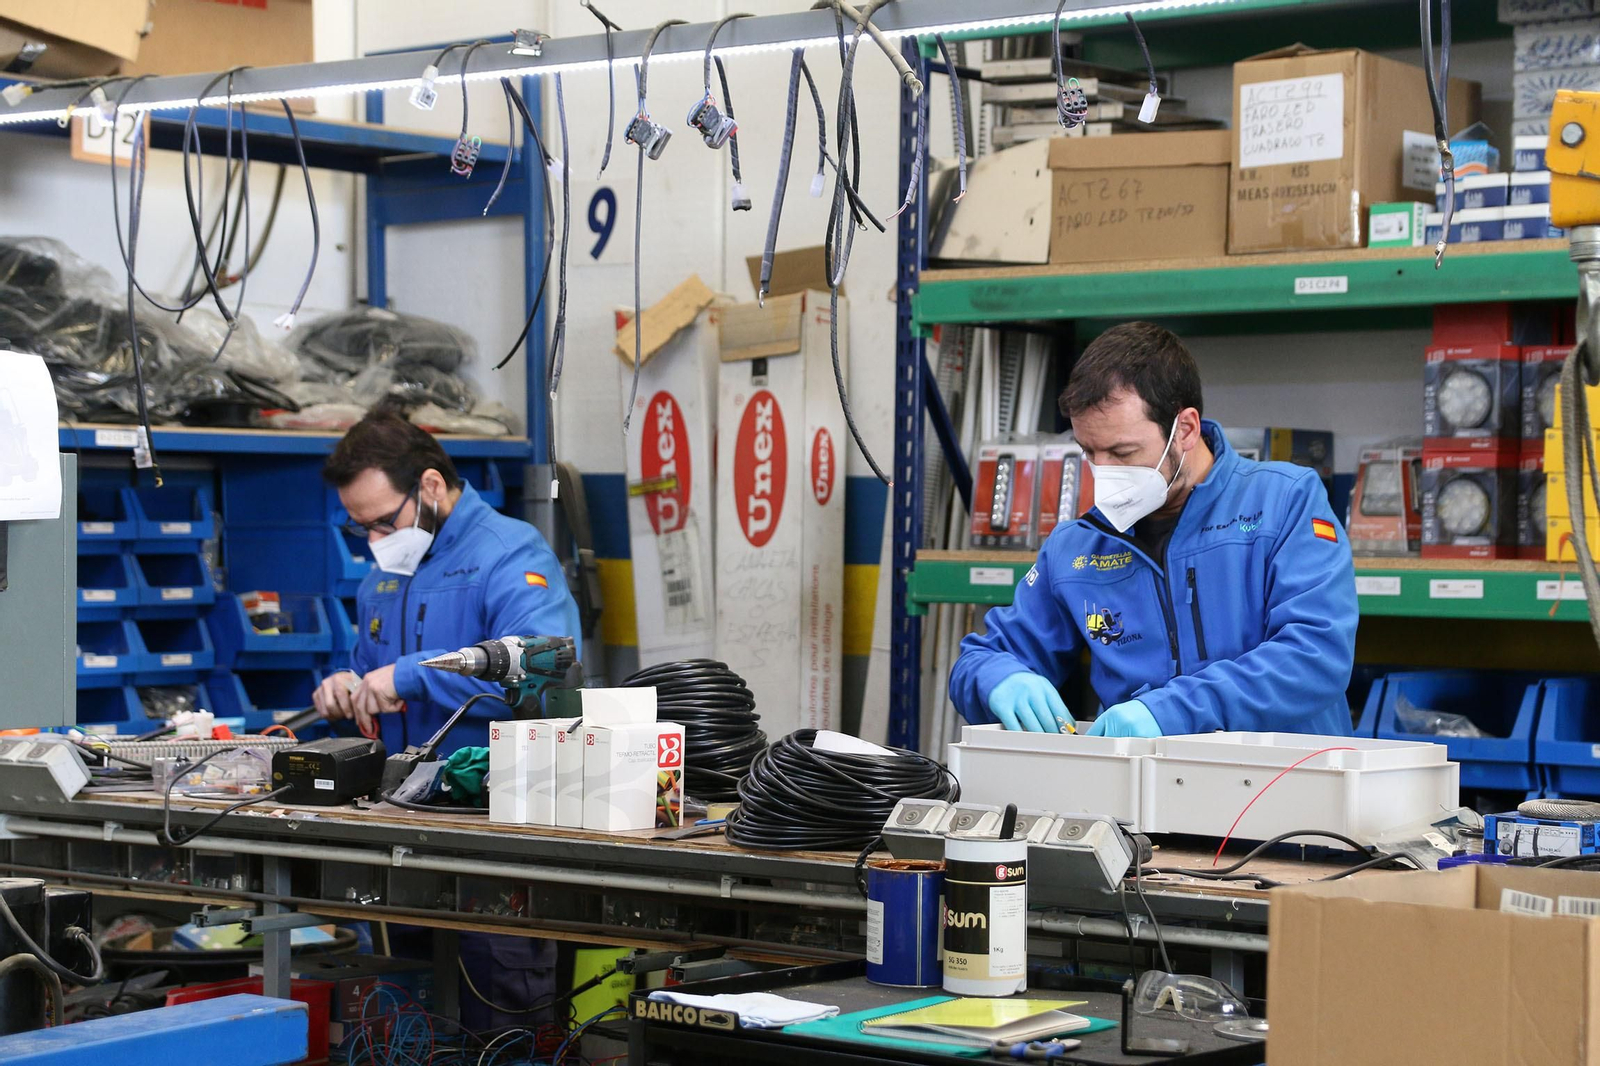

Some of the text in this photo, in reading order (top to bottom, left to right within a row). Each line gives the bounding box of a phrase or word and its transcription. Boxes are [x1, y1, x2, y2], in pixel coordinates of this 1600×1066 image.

[1282, 101, 1316, 118] LED
[1242, 117, 1304, 140] TRASERO
[587, 186, 617, 261] 9
[1098, 208, 1128, 227] LED
[747, 398, 774, 538] Unex
[815, 431, 831, 500] Unex
[1238, 514, 1252, 523] For
[1089, 556, 1133, 568] AMATE
[944, 909, 987, 929] sum
[956, 957, 968, 966] 350
[352, 985, 360, 997] 4
[635, 1000, 698, 1025] BAHCO
